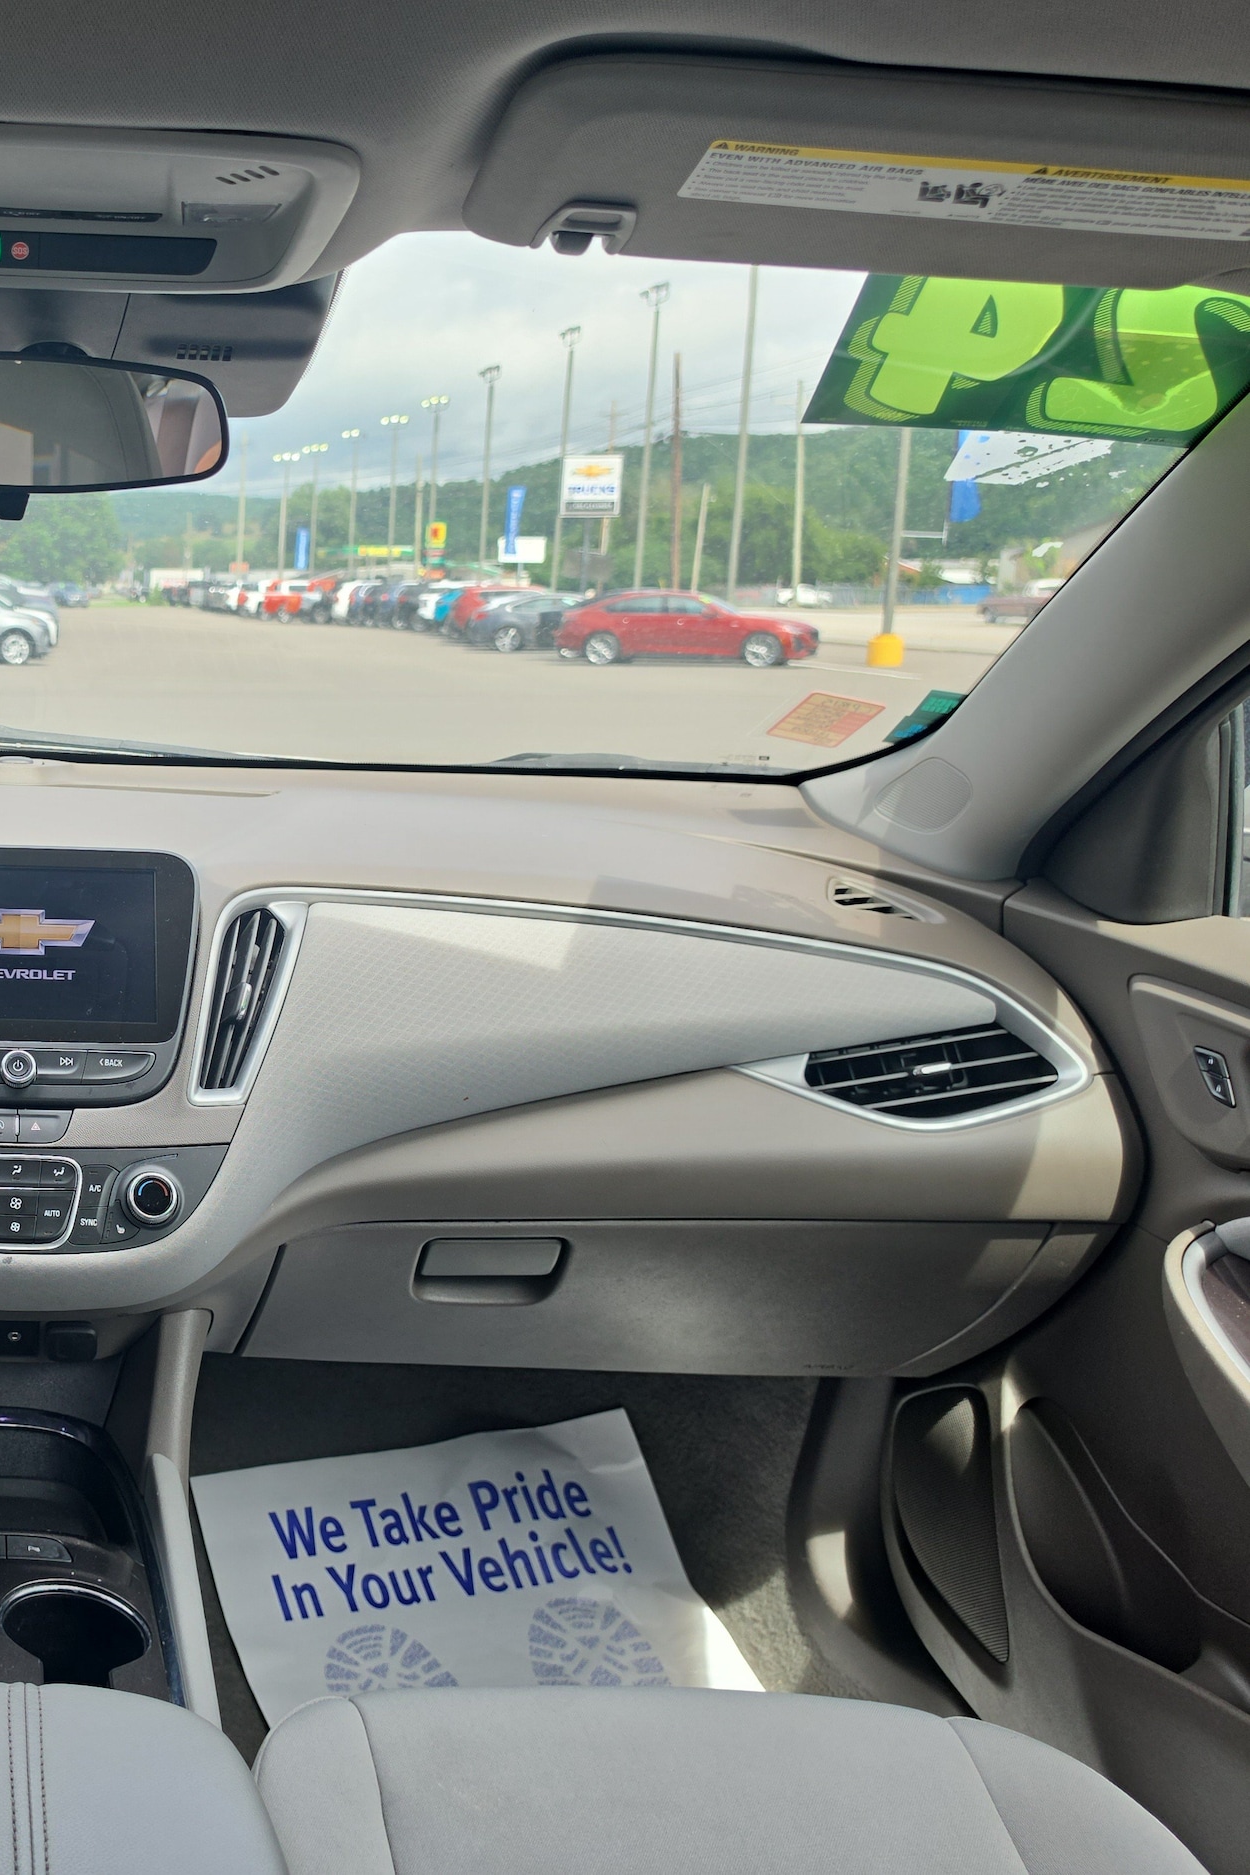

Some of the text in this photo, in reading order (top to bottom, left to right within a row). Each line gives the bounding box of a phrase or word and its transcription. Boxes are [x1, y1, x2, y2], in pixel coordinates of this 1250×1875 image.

[734, 144, 800, 156] WARNING
[709, 152, 746, 161] EVEN
[749, 155, 783, 164] WITH
[786, 158, 856, 171] ADVANCED
[859, 164, 884, 173] AIR
[886, 167, 924, 176] BAGS
[1053, 168, 1172, 185] AVERTISSEMENT
[1056, 179, 1085, 188] AVEC
[1087, 181, 1109, 189] DES
[1111, 183, 1140, 192] SACS
[1141, 186, 1211, 197] GONFLABLES
[12, 244, 29, 256] SOS
[103, 1058, 123, 1067] BACK
[88, 1184, 102, 1193] A/C
[43, 1209, 61, 1218] AUTO
[79, 1218, 98, 1227] SYNC
[268, 1468, 593, 1560] We Take Pride
[271, 1526, 634, 1621] In Your Vehicle!
